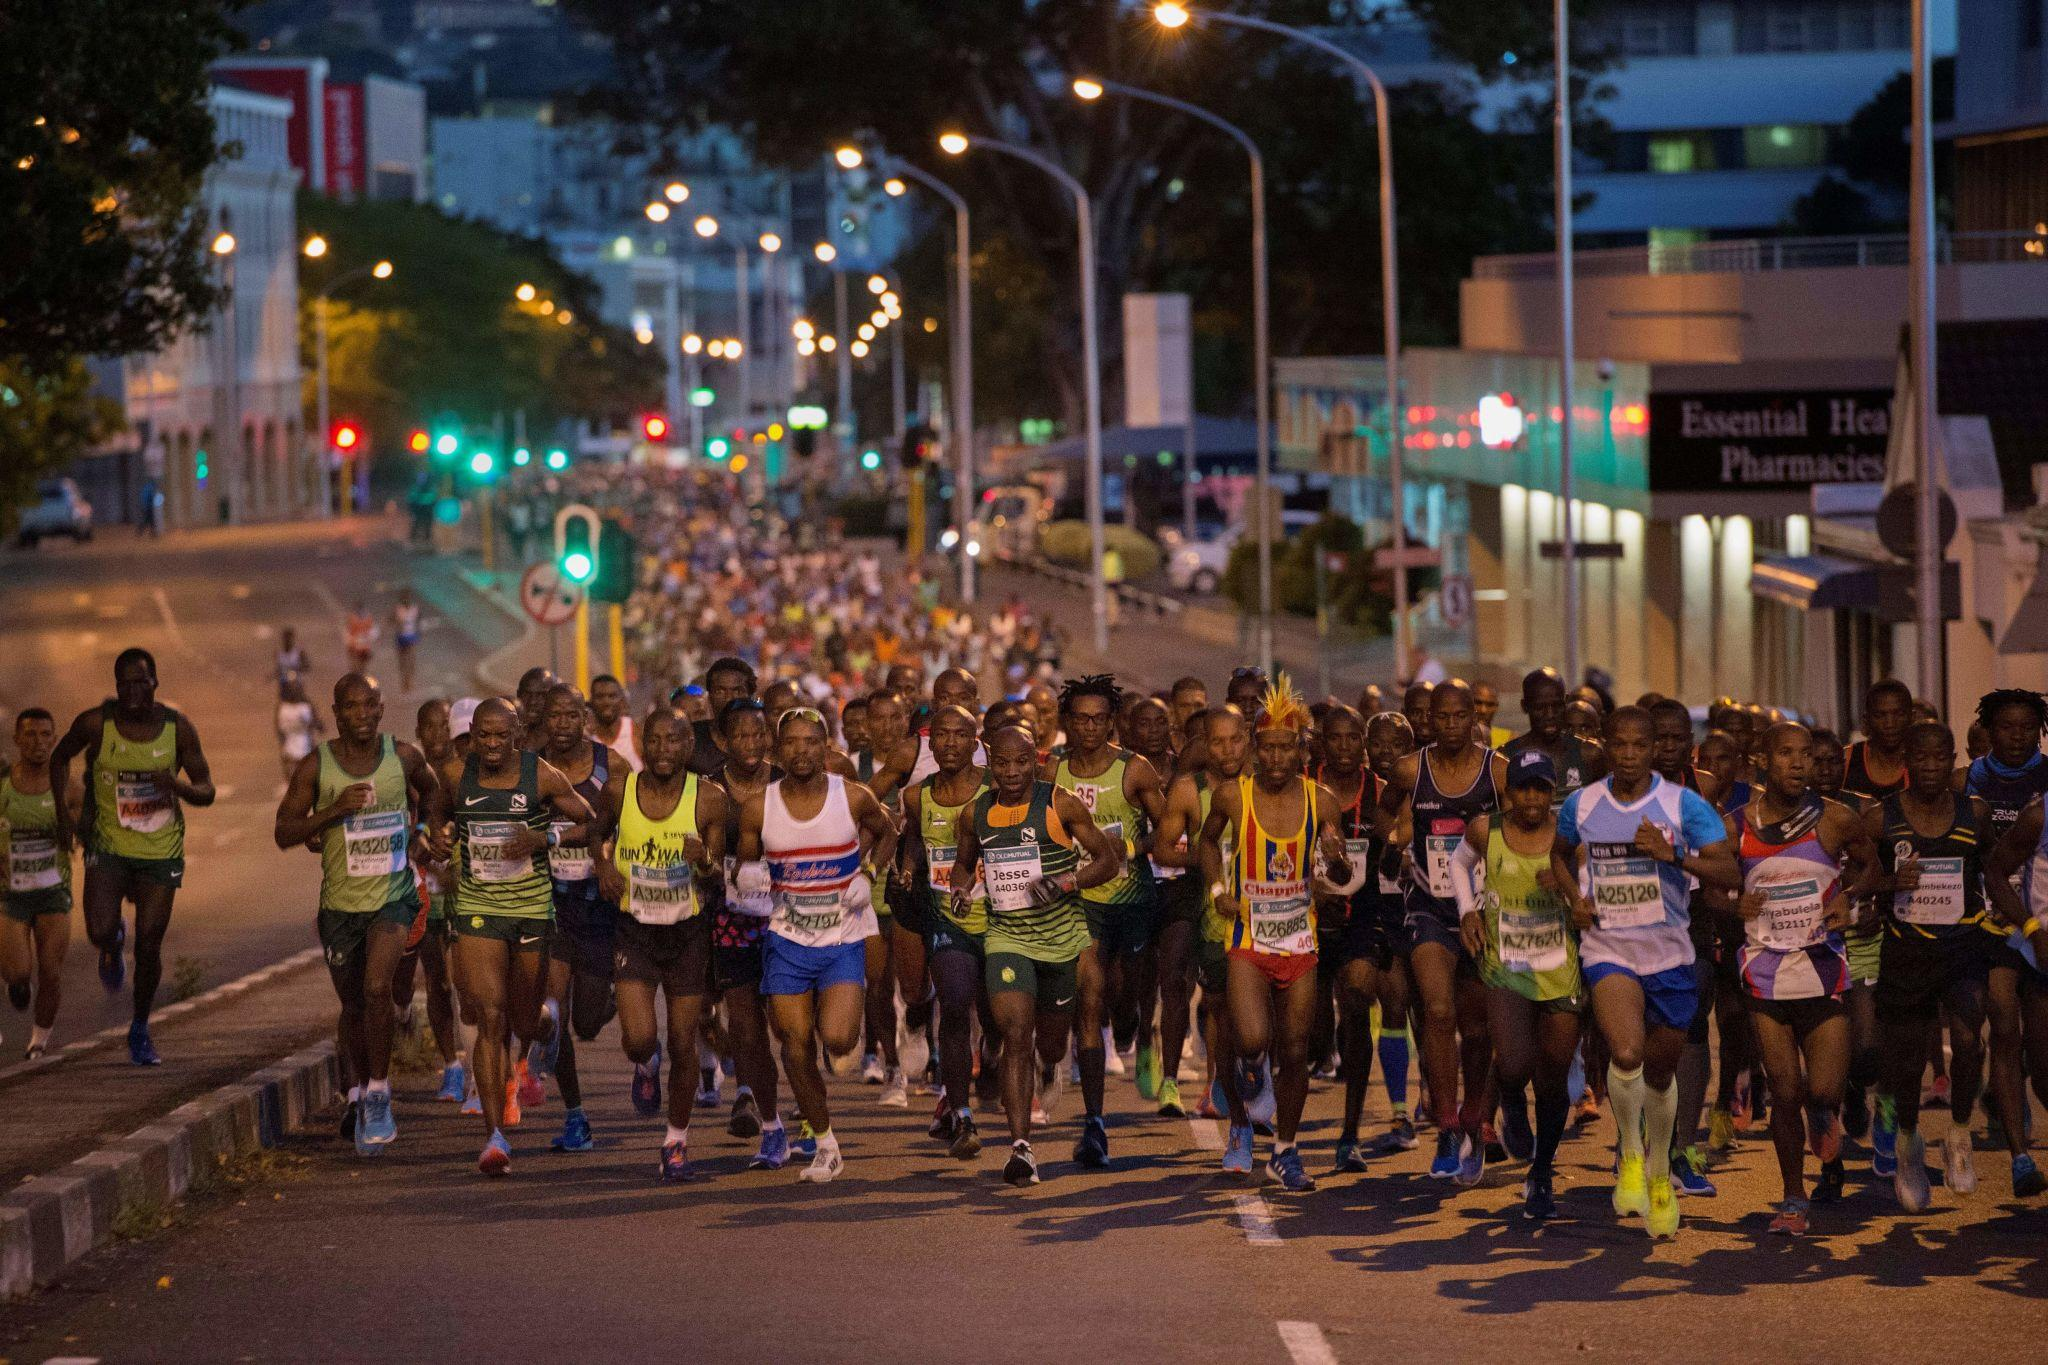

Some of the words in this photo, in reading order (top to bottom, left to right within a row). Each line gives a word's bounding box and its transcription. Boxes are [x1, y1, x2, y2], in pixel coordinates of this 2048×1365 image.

[1681, 399, 1808, 437] Essential
[1829, 399, 1892, 437] Hea
[1721, 444, 1886, 482] Pharmacies
[1994, 808, 2019, 816] RUN
[620, 847, 640, 860] RUN
[657, 848, 684, 861] WA
[993, 869, 1030, 881] Jesse
[1597, 884, 1658, 905] A25120
[1256, 914, 1307, 938] A26885
[1771, 917, 1813, 931] A32117
